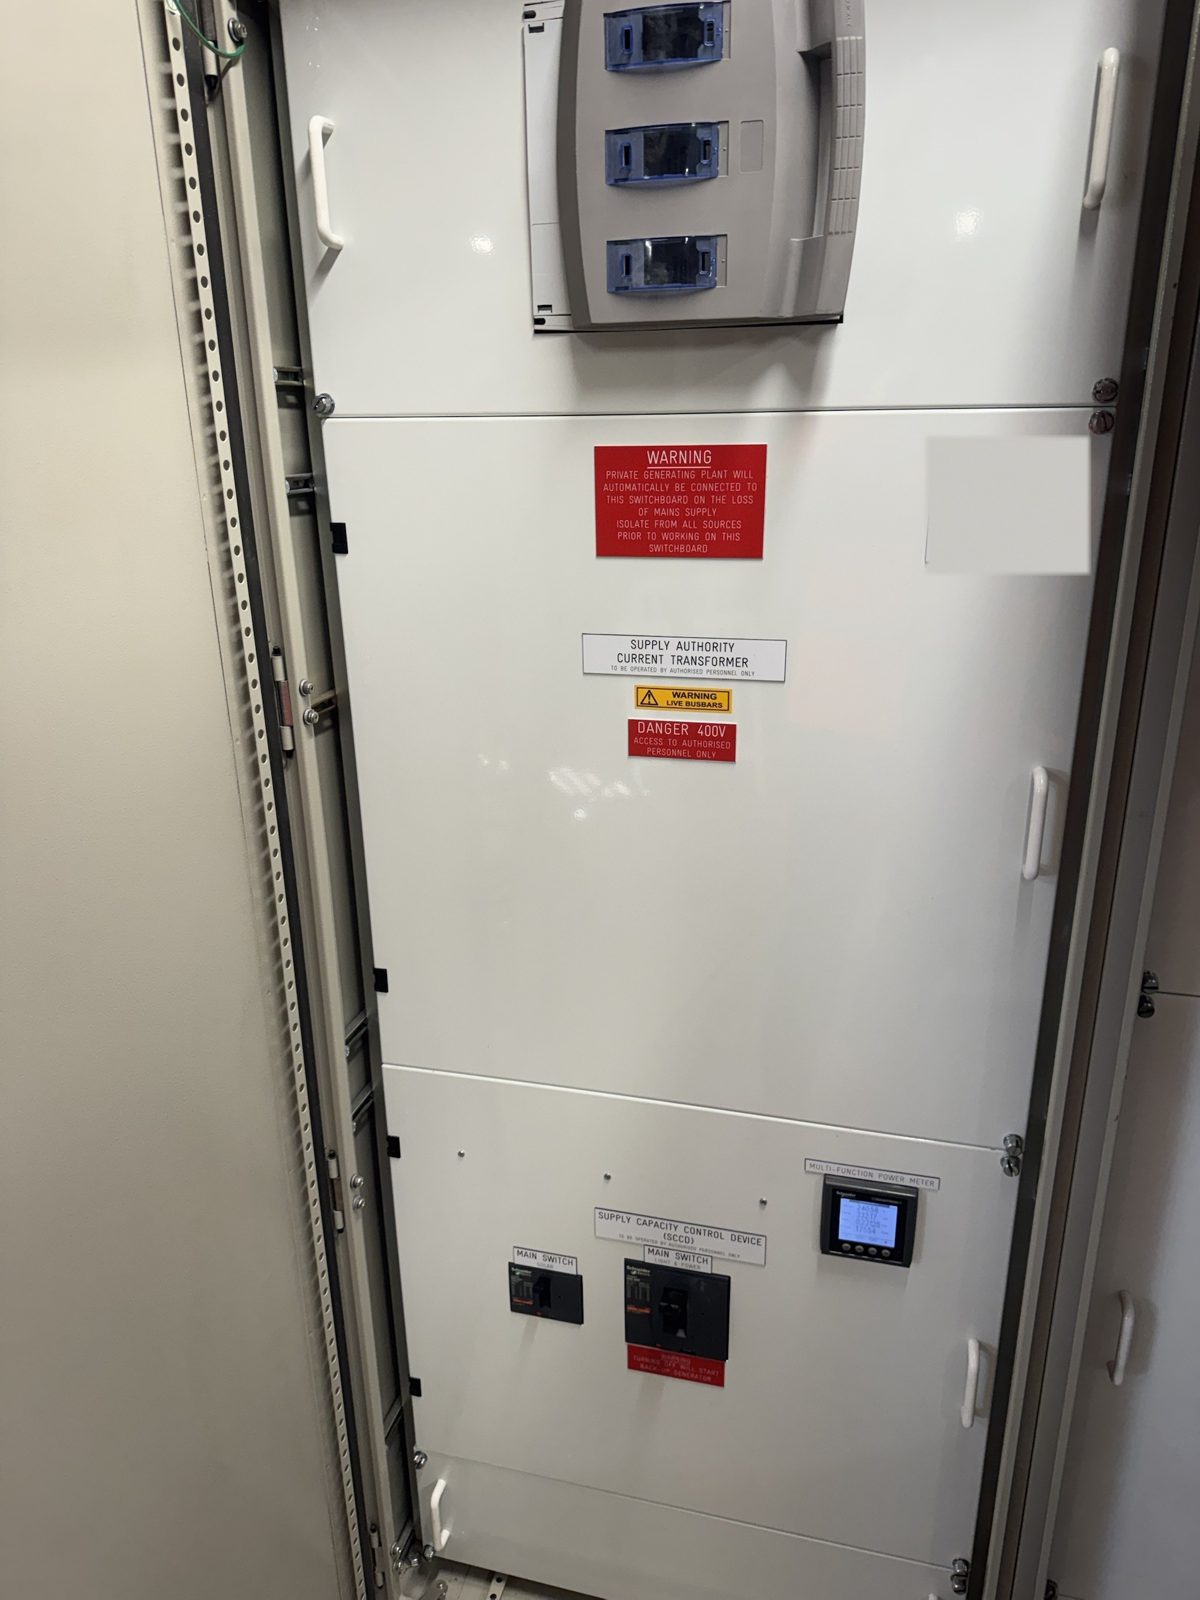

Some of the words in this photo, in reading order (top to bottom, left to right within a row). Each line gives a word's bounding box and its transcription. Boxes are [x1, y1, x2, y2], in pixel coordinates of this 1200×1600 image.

[647, 450, 712, 464] WARNING
[606, 470, 639, 479] PRIVATE
[643, 470, 695, 479] GENERATING
[701, 470, 728, 479] PLANT
[732, 470, 753, 479] WILL
[603, 483, 670, 492] AUTOMATICALLY
[674, 483, 686, 491] BE
[690, 483, 741, 491] CONNECTED
[746, 482, 758, 491] TO
[606, 495, 624, 504] THIS
[629, 495, 688, 504] SWITCHBOARD
[694, 495, 705, 504] ON
[711, 495, 726, 504] THE
[731, 495, 754, 504] LOSS
[638, 508, 649, 517] OF
[654, 508, 680, 517] MAINS
[685, 508, 717, 517] SUPPLY
[616, 520, 649, 529] ISOLATE
[654, 520, 677, 529] FROM
[683, 520, 697, 529] ALL
[703, 520, 742, 529] SOURCES
[617, 532, 641, 540] PRIOR
[647, 532, 656, 541] TO
[662, 532, 699, 541] WORKING
[705, 532, 717, 541] ON
[722, 532, 741, 541] THIS
[649, 544, 708, 553] SWITCHBOARD
[630, 639, 670, 651] SUPPLY
[676, 641, 735, 653] AUTHORITY
[617, 653, 664, 665] CURRENT
[671, 655, 749, 668] TRANSFORMER
[672, 691, 717, 700] WARNING
[685, 701, 723, 709] BUSBARS
[637, 721, 689, 736] DANGER
[697, 725, 726, 737] 400V
[633, 737, 663, 746] ACCESS
[682, 740, 731, 750] AUTHORISED
[646, 748, 692, 758] PERSONNEL
[696, 751, 717, 759] ONLY
[809, 1162, 874, 1178] MULTI-FUNCTION
[878, 1171, 904, 1182] POWER
[909, 1178, 935, 1187] METER
[598, 1212, 632, 1224] SUPPLY
[636, 1218, 679, 1232] CAPACITY
[683, 1226, 724, 1240] CONTROL
[730, 1233, 762, 1246] DEVICE
[663, 1233, 695, 1244] (SCCD)
[516, 1250, 537, 1260] MAIN
[542, 1255, 574, 1266] SWITCH
[647, 1248, 670, 1258] MAIN
[675, 1252, 709, 1265] SWITCH
